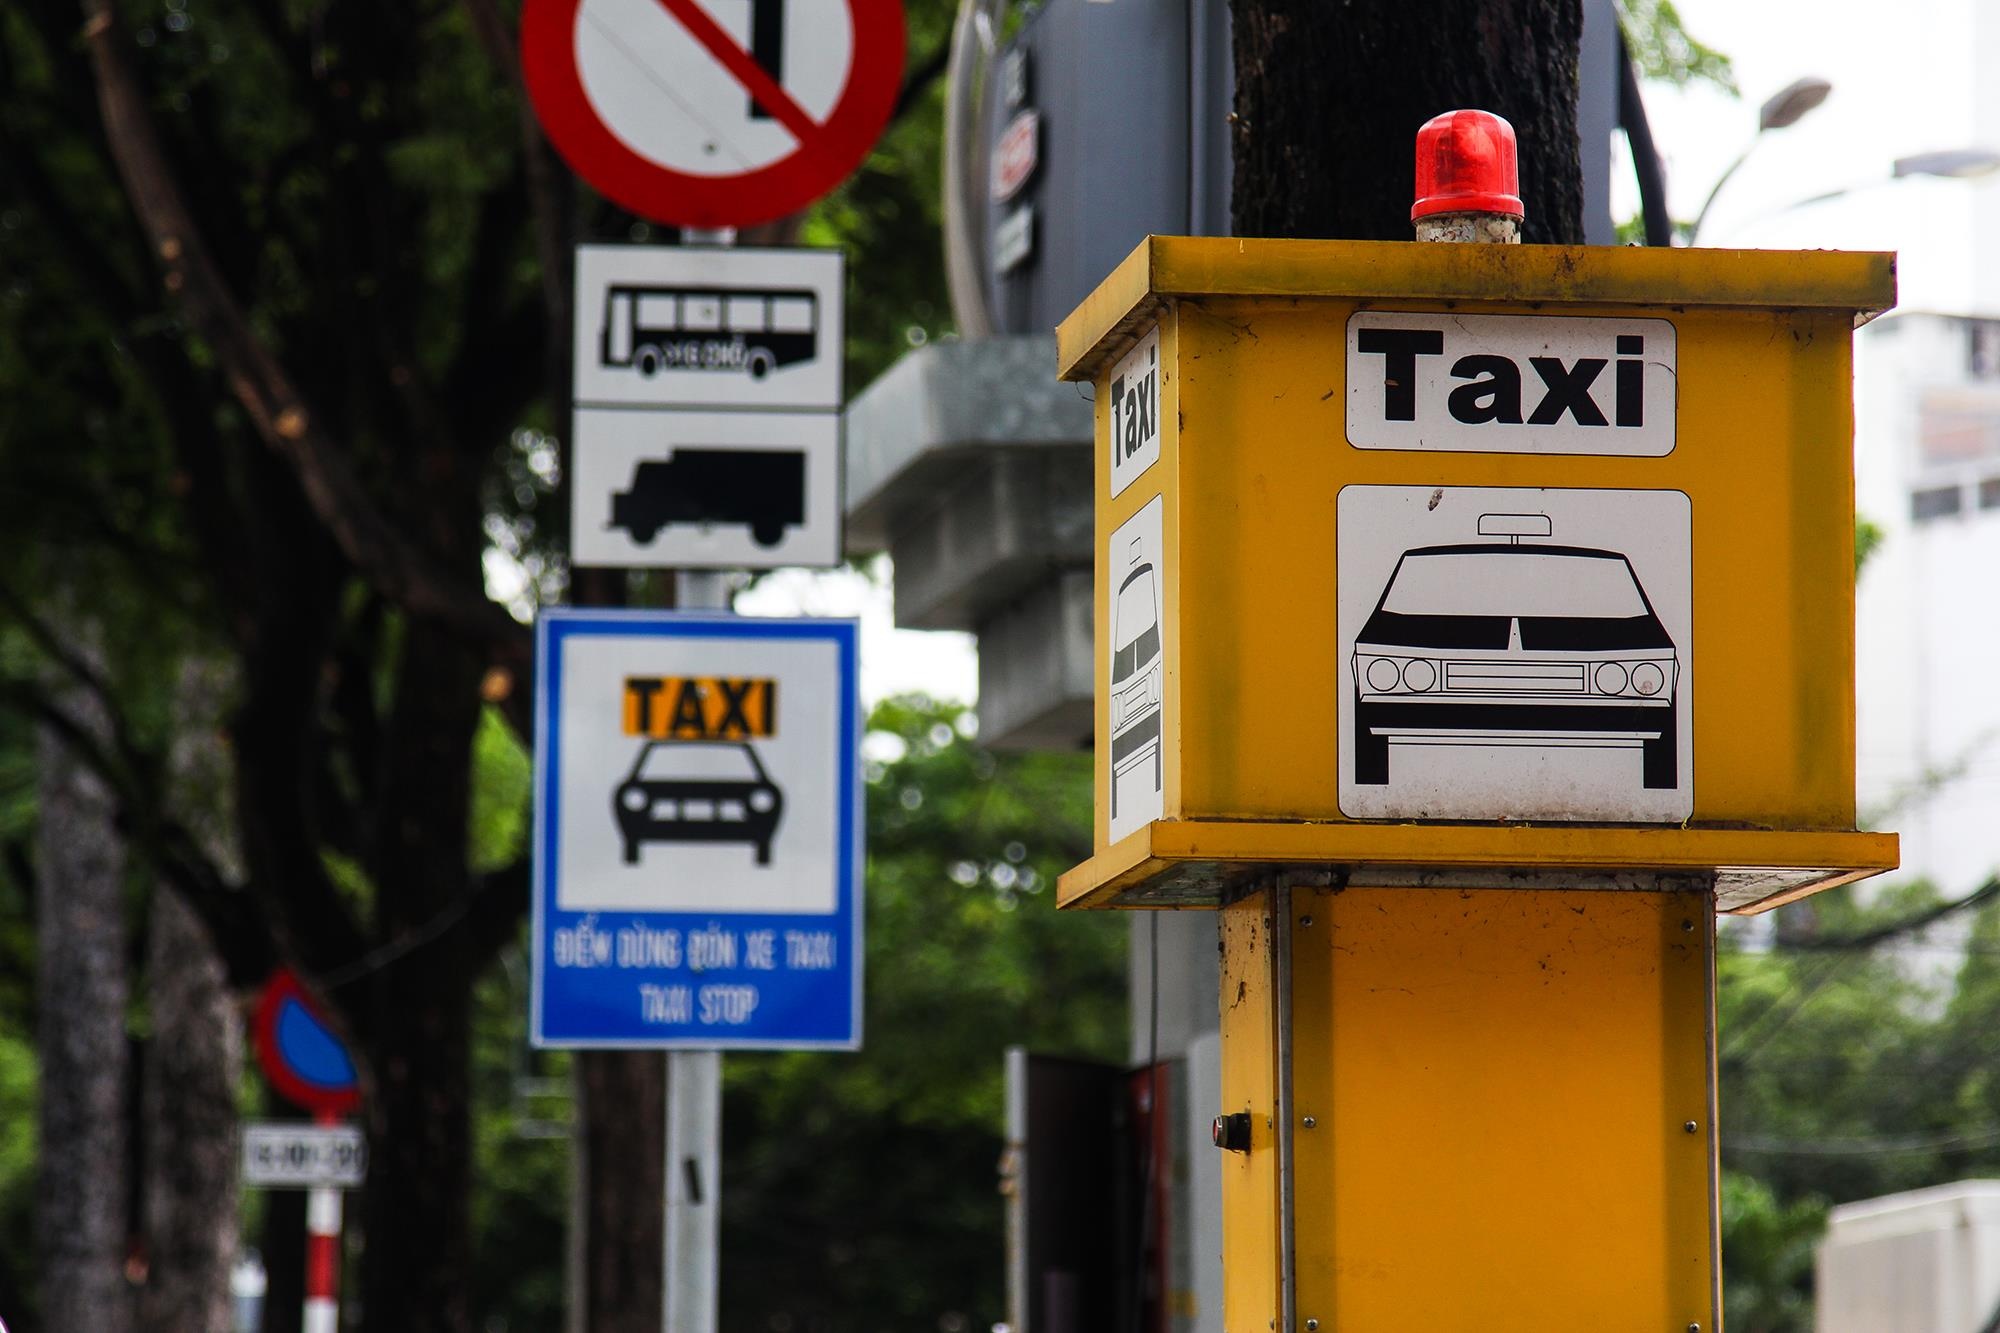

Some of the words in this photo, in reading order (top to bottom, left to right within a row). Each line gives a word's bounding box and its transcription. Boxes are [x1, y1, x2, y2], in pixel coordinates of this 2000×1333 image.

[1357, 328, 1644, 427] Taxi
[1112, 346, 1156, 468] Taxi
[627, 679, 776, 735] TAXI
[744, 929, 776, 970] XE
[785, 929, 838, 970] TAXI
[640, 983, 692, 1023] TAXI
[699, 984, 758, 1024] STOP
